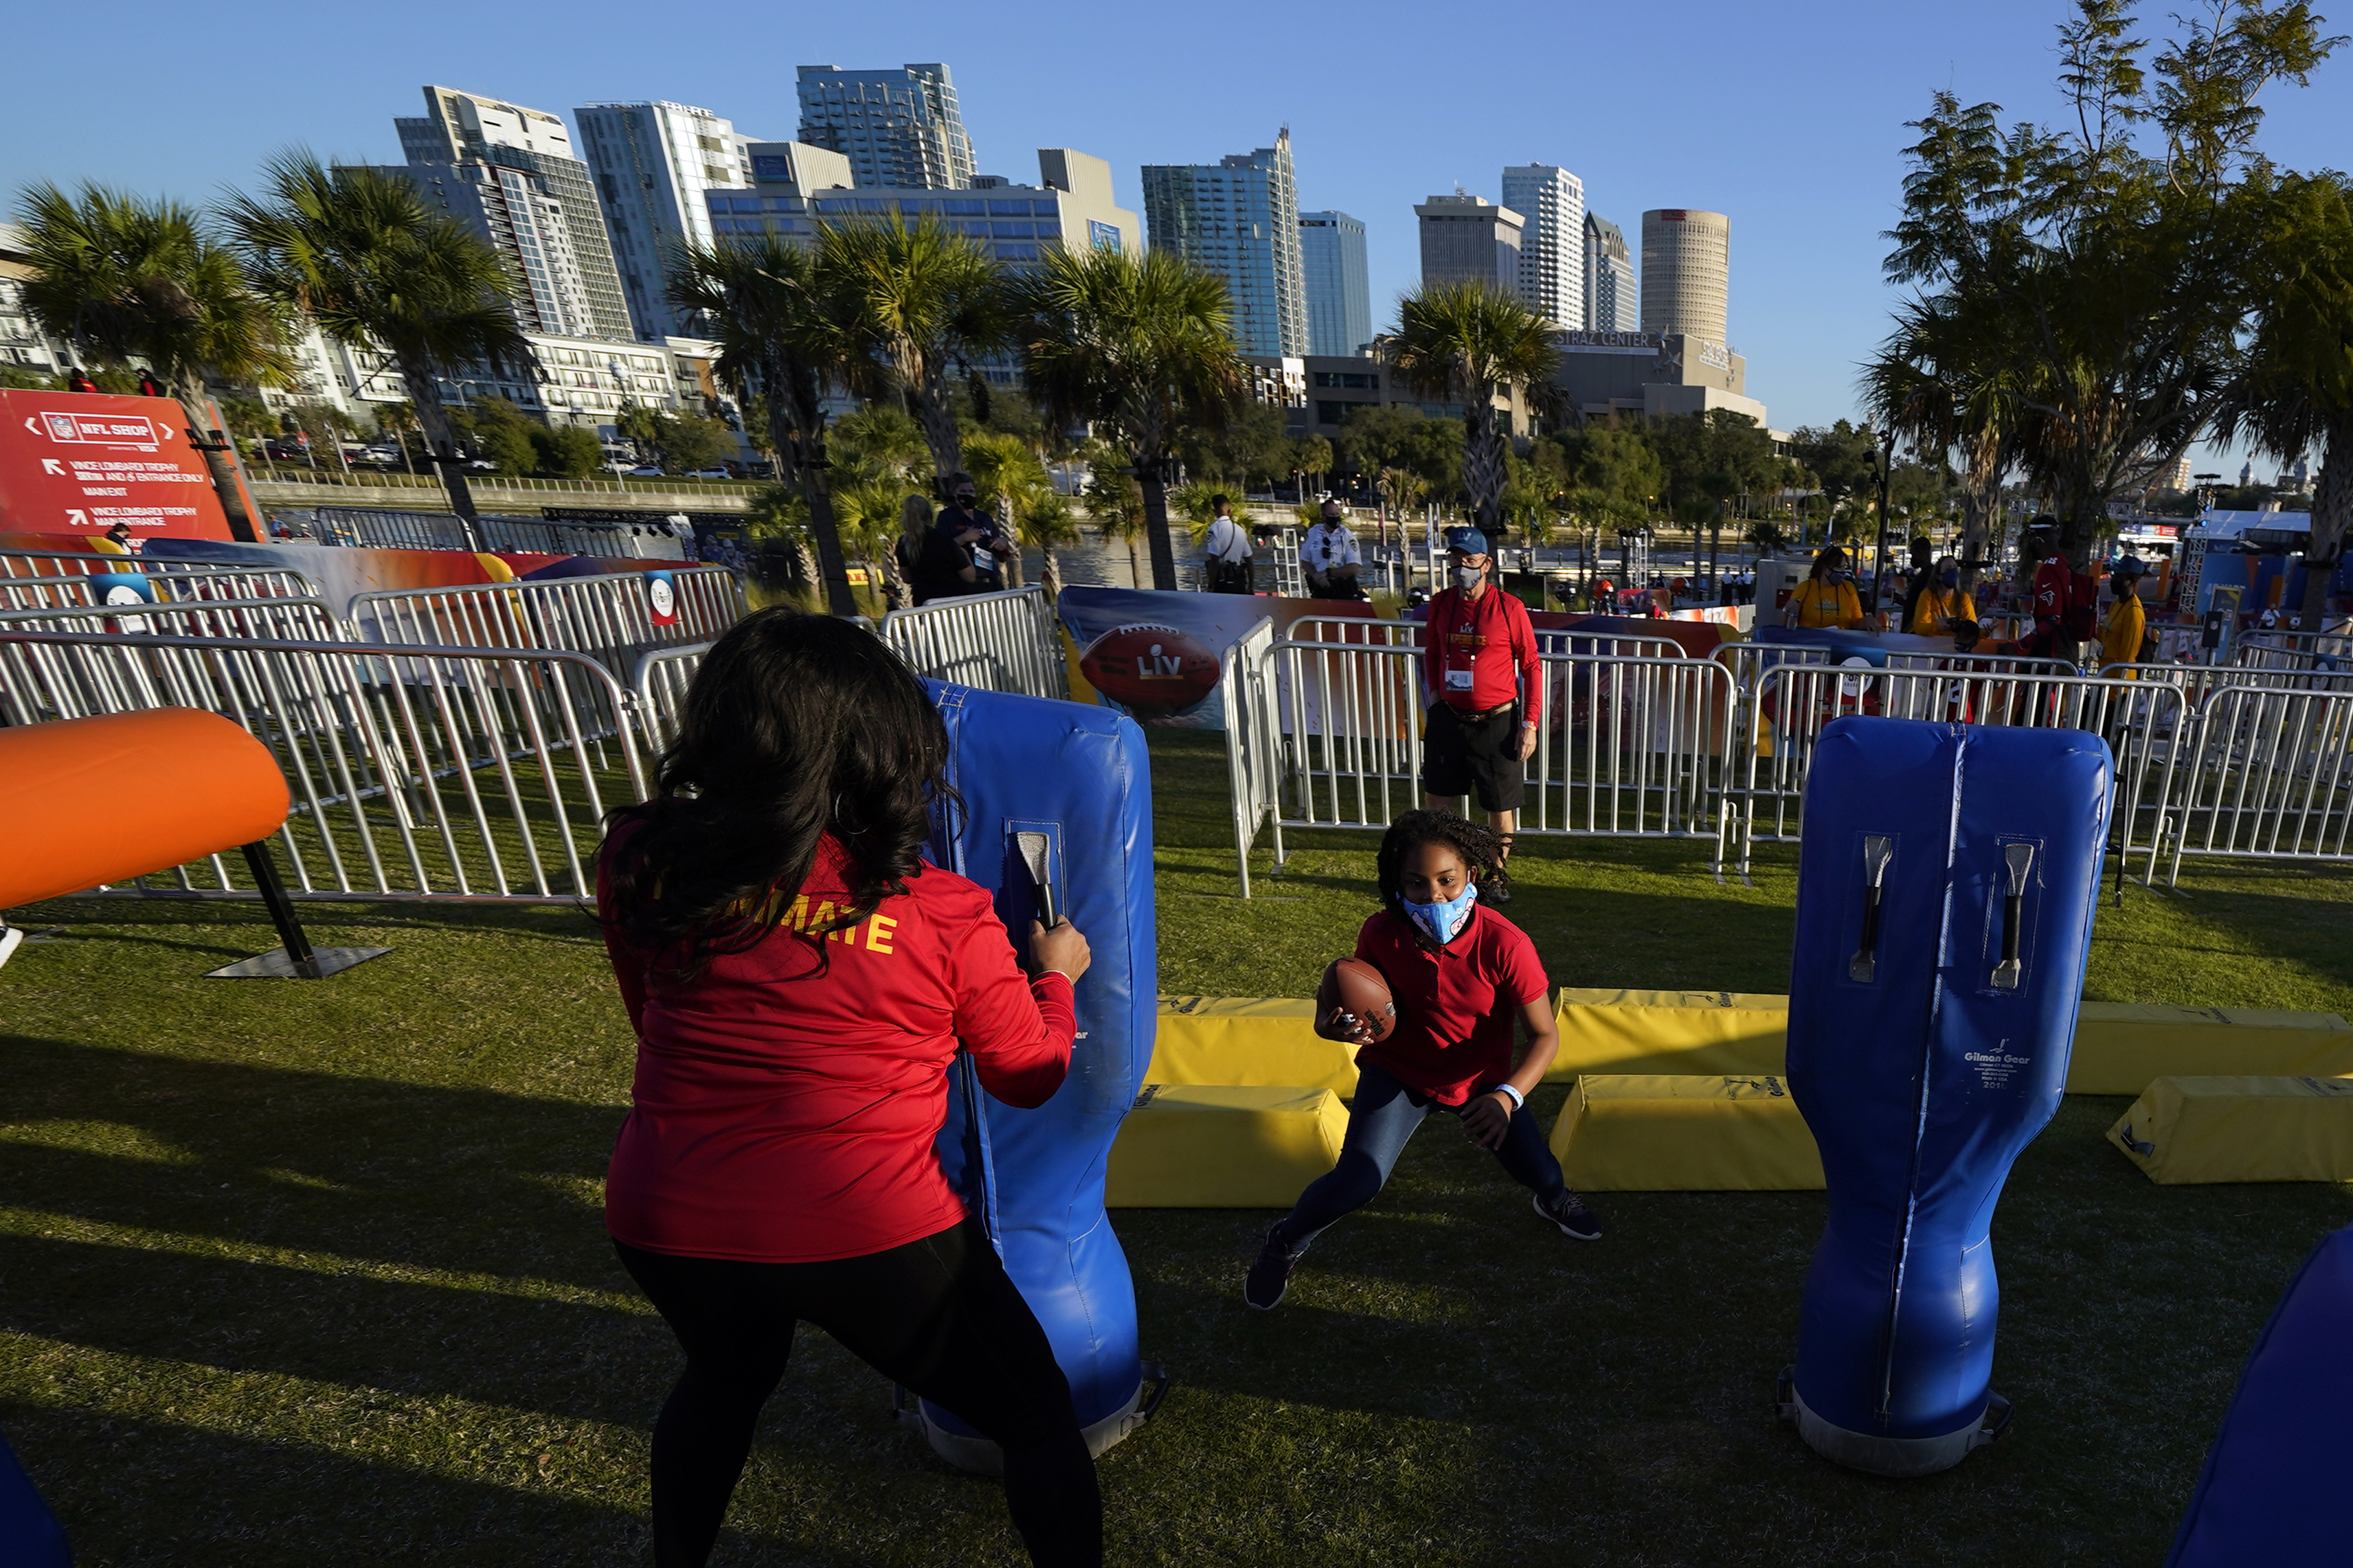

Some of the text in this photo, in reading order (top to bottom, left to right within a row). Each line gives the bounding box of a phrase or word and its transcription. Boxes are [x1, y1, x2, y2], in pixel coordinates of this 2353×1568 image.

[1556, 331, 1649, 347] STRAZ CENTER
[79, 424, 150, 436] NFL SHOP
[69, 461, 179, 472] VINCE LOMBARDI TROPHY
[106, 472, 125, 481] AND
[136, 473, 182, 482] ENTRANCE
[180, 474, 204, 483] ONLY
[82, 487, 128, 497] MAIN EXIT
[89, 507, 198, 516] VINCE LOMBARDI TROPHY
[93, 517, 167, 526] MAIN ENTRANCE
[1136, 655, 1181, 675] LIV
[1964, 1052, 2030, 1064] Gilman Gear
